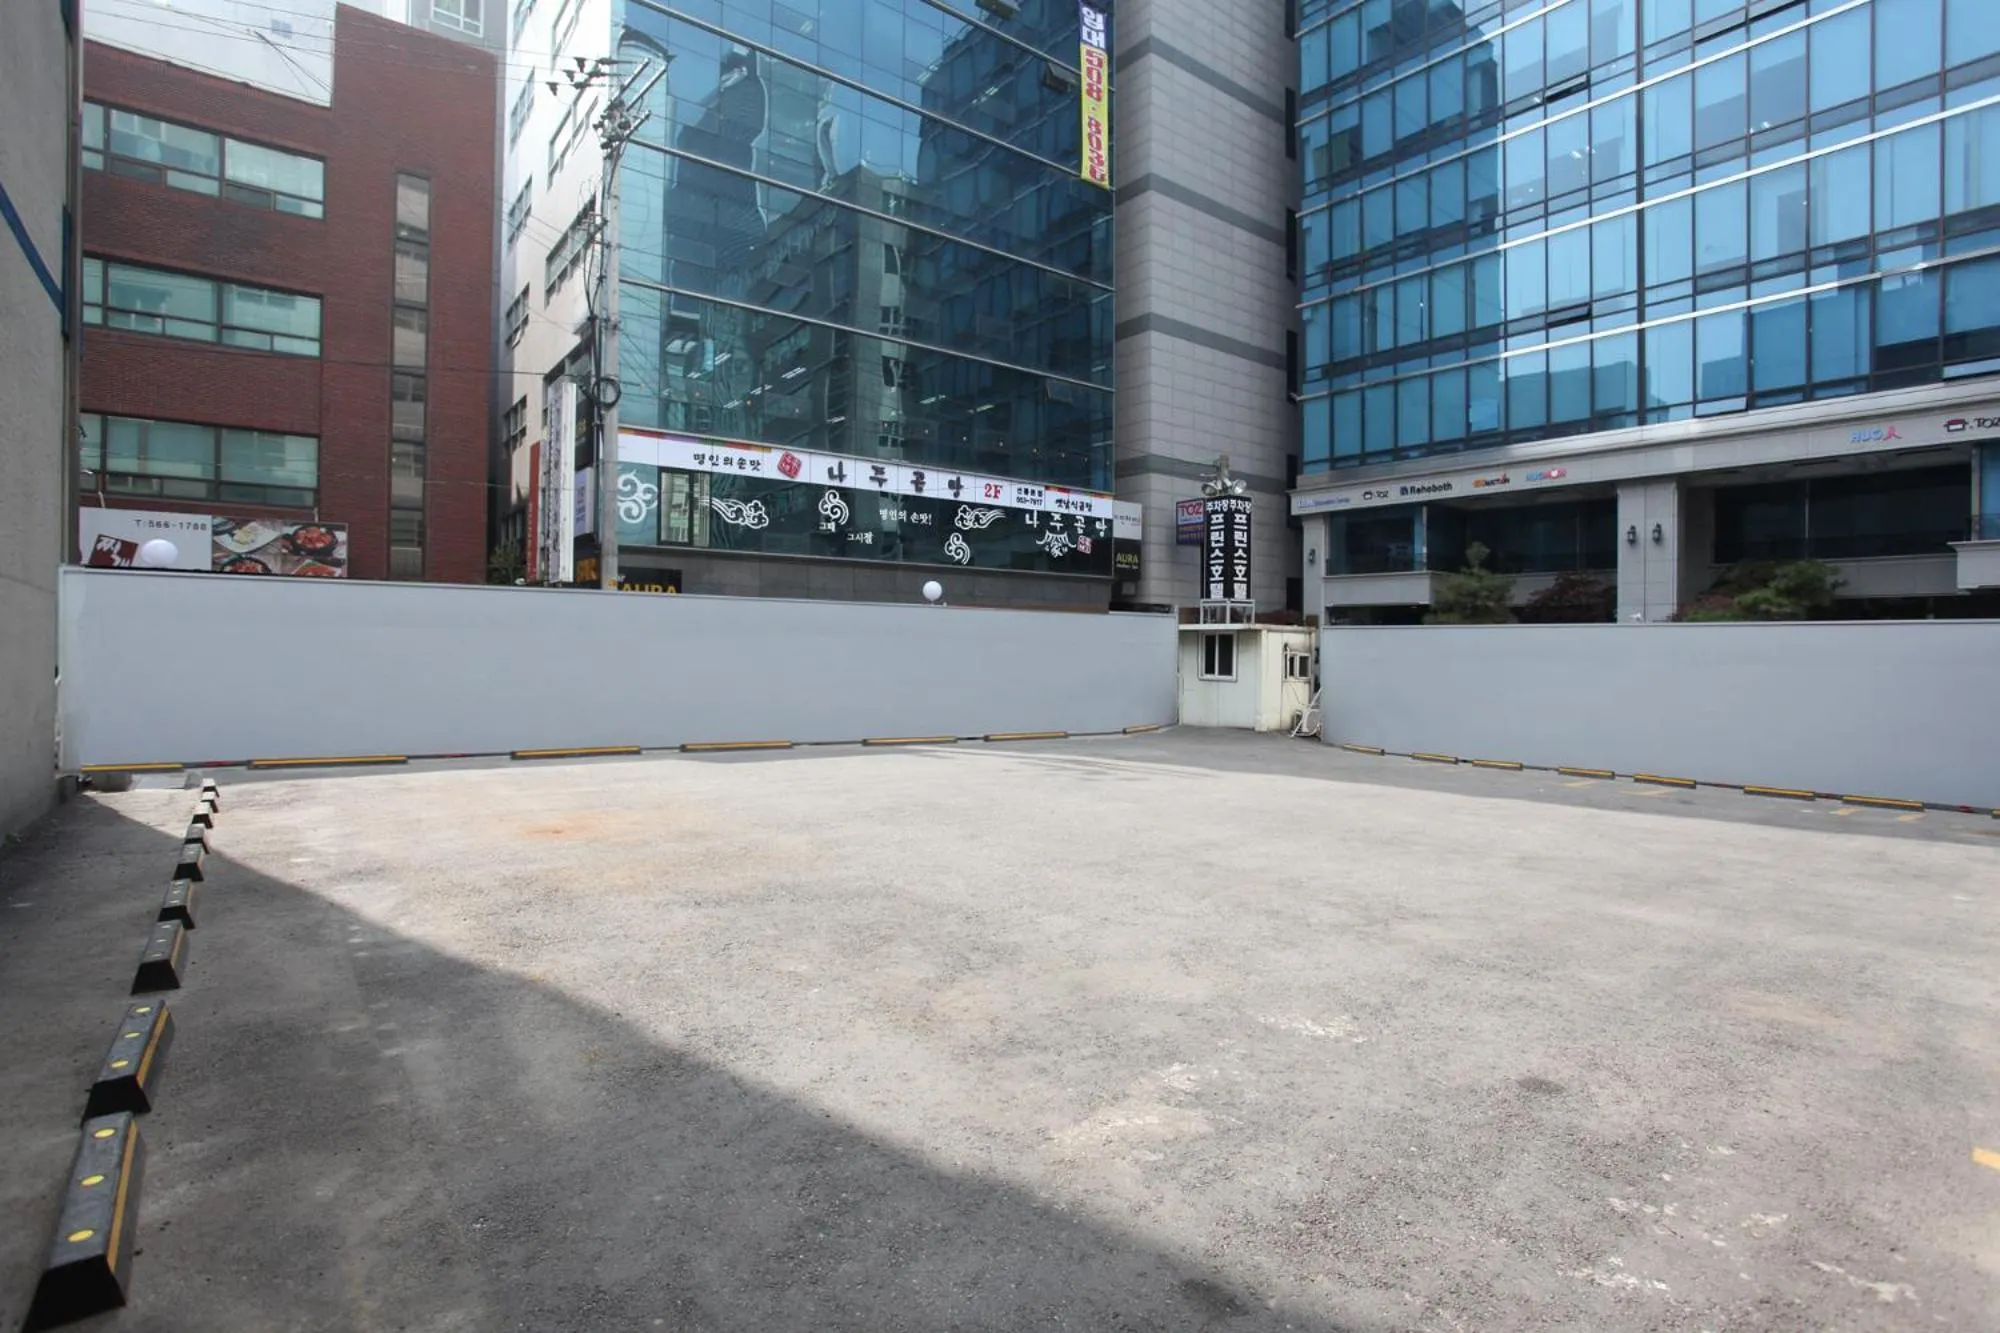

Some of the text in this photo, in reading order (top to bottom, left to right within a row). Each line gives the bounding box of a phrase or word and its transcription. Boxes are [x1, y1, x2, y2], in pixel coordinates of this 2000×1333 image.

[984, 483, 1003, 499] 2F
[1410, 482, 1453, 495] Rehoboth
[1206, 499, 1229, 512] 주차장
[1230, 499, 1252, 513] 주차장
[1116, 552, 1139, 564] AURA
